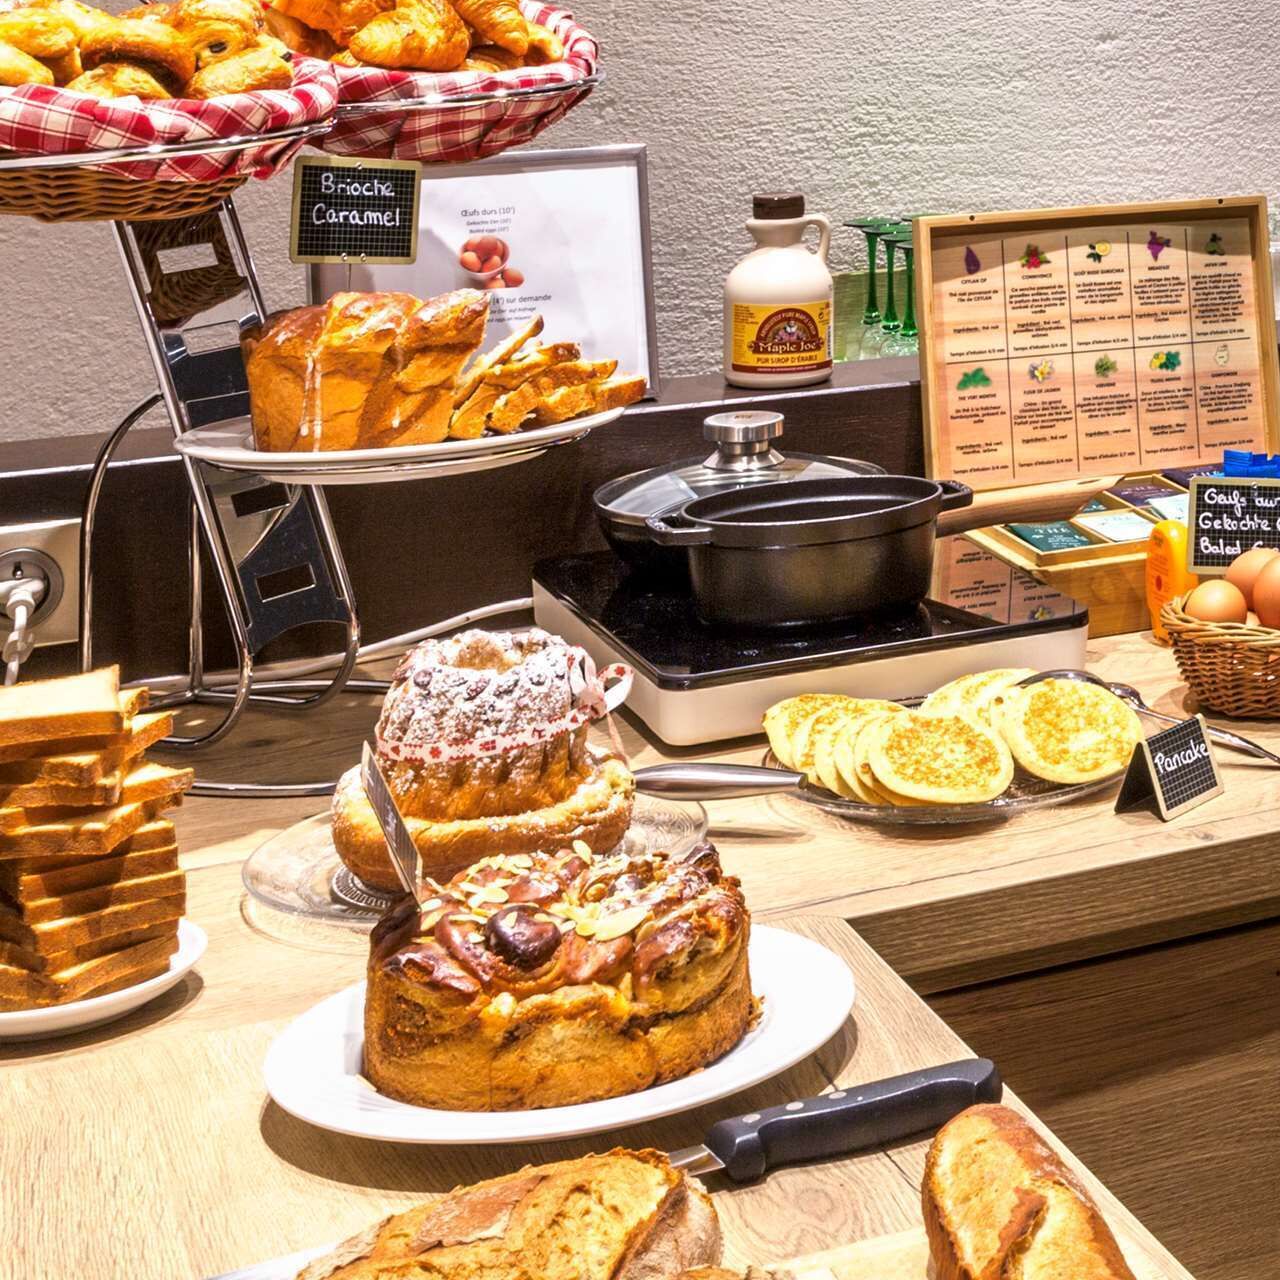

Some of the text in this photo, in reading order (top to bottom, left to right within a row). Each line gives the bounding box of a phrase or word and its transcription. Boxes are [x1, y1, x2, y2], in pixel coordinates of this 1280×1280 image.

[321, 173, 395, 196] Brioche
[313, 203, 400, 226] Caramel
[481, 206, 497, 215] durs
[518, 293, 552, 303] demande
[759, 341, 816, 353] Maple Joe
[1199, 512, 1271, 530] Gekochte
[1154, 739, 1210, 773] Pancake
